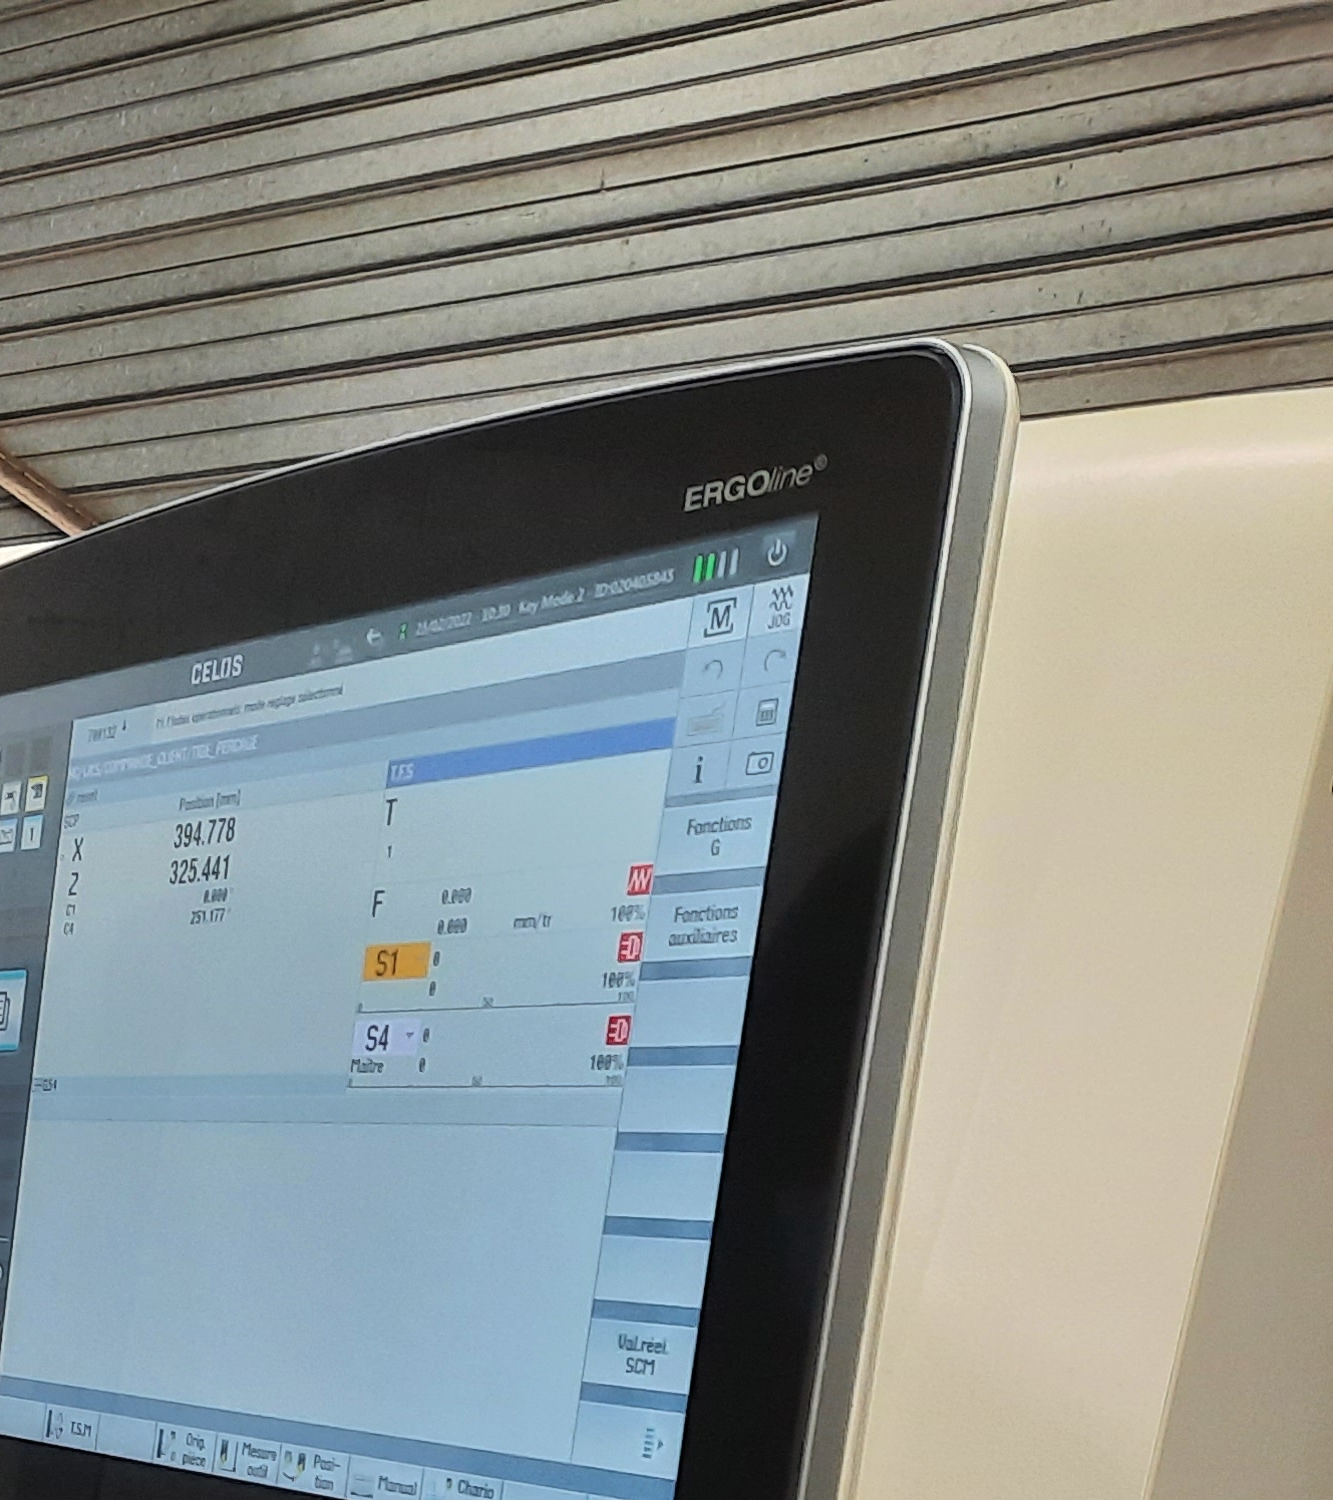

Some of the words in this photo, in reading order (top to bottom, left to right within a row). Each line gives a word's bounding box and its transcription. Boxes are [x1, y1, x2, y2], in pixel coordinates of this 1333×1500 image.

[767, 611, 791, 630] JOG
[190, 654, 244, 685] CELOS
[385, 798, 398, 826] T
[686, 816, 753, 836] Fonctions
[72, 837, 84, 862] X
[173, 817, 237, 850] 394.778
[67, 872, 80, 896] Z
[168, 854, 231, 886] 325.441
[371, 890, 386, 917] F
[673, 905, 739, 923] Fonctions
[375, 949, 399, 977] S1
[364, 1024, 389, 1052] S4
